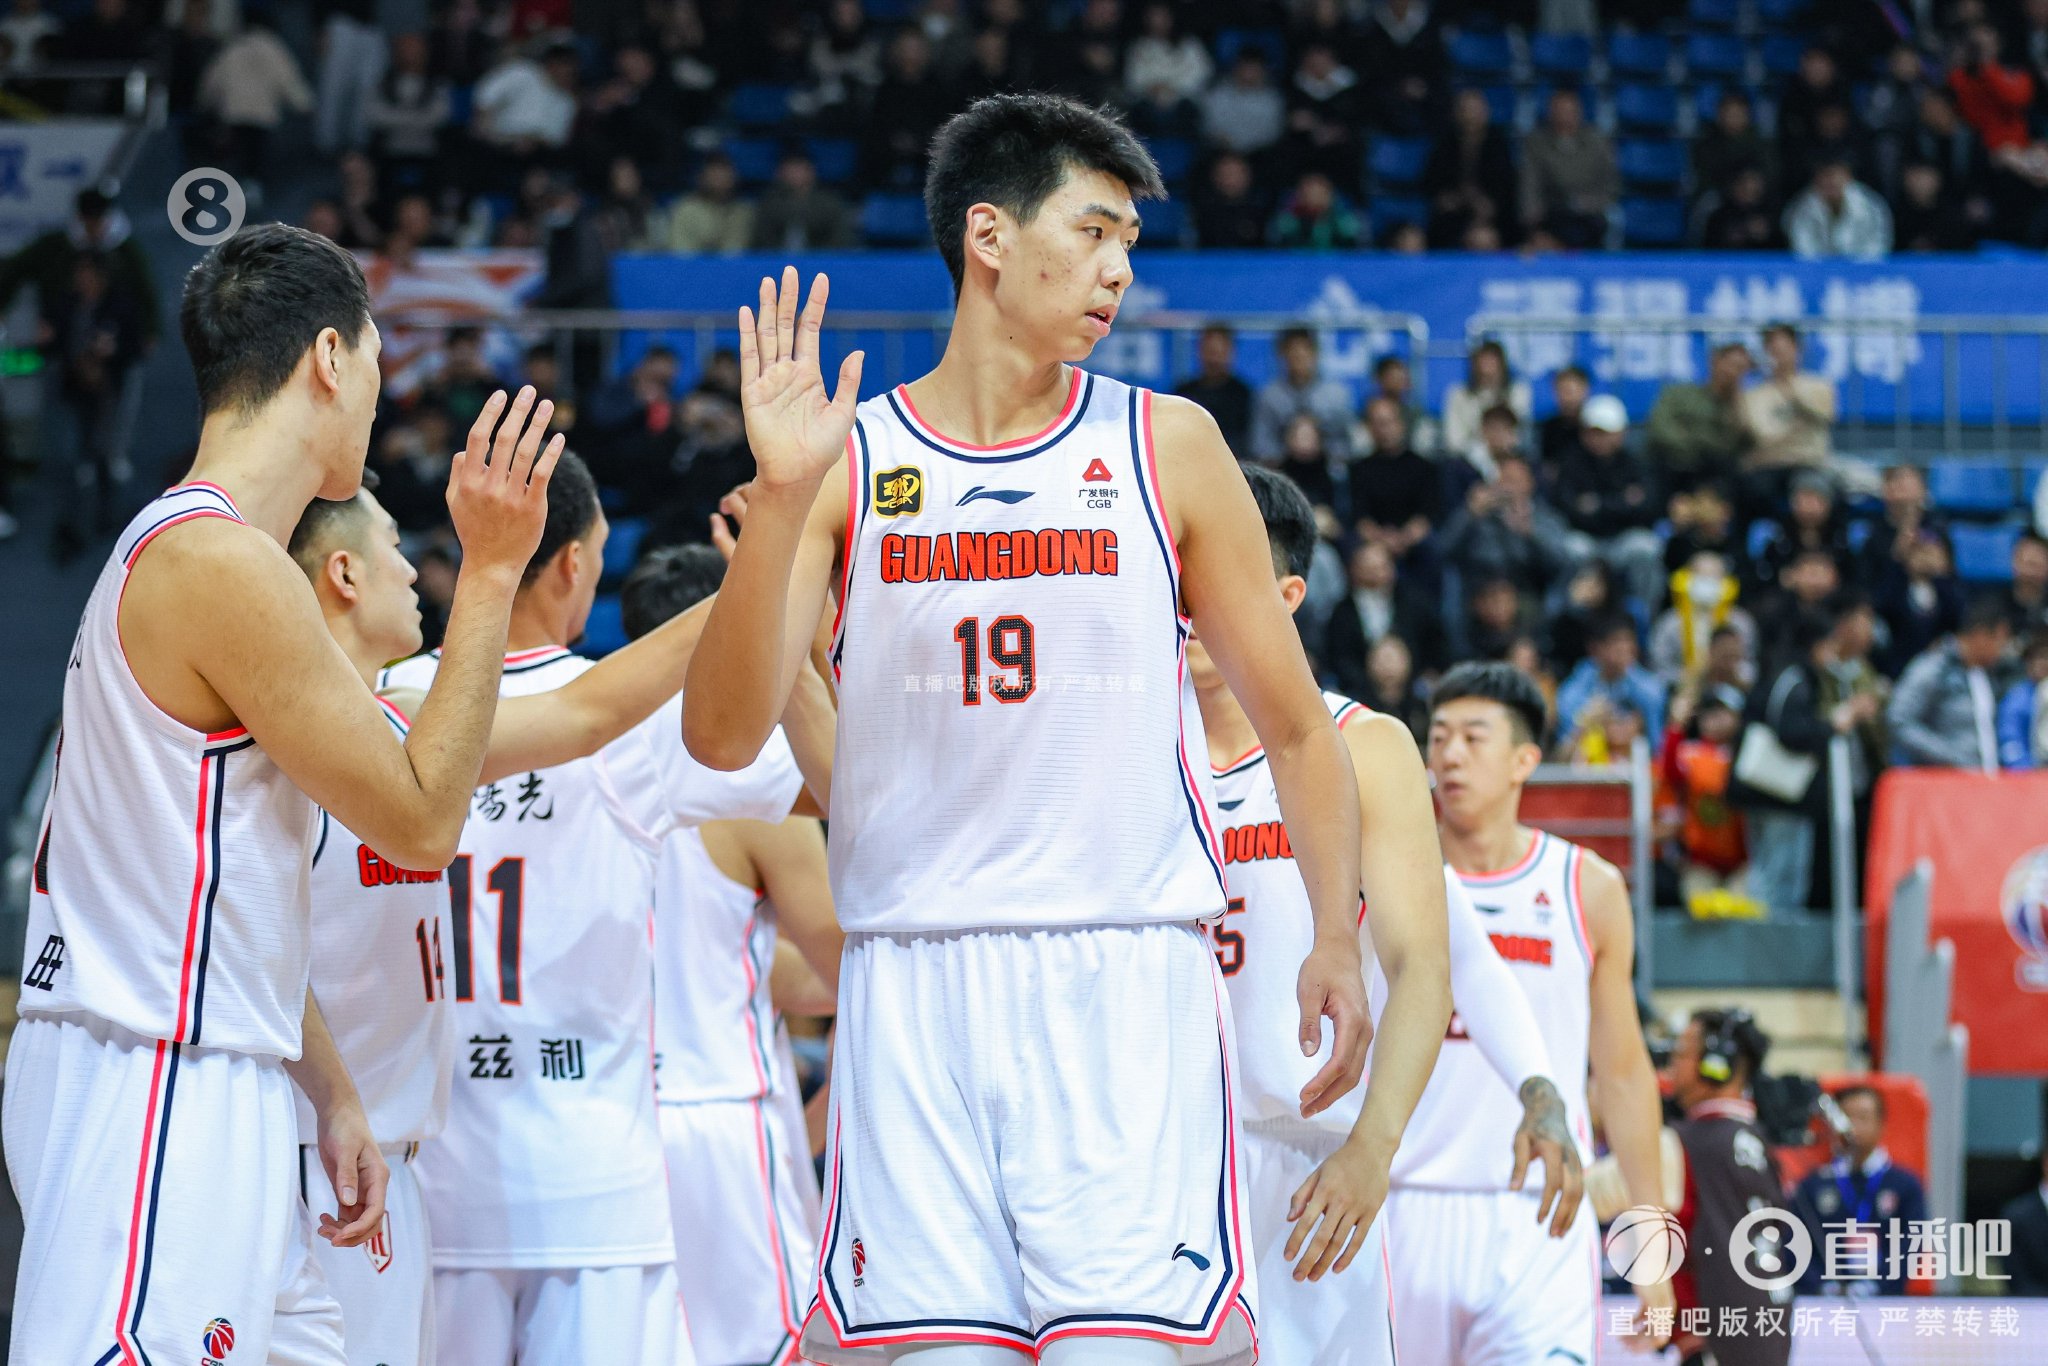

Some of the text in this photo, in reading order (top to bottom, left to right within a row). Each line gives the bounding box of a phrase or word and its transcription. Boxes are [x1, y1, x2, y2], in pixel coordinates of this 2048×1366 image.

[1078, 488, 1119, 499] 广发银行
[1086, 499, 1112, 509] CGB
[880, 528, 1119, 584] GUANGDONG
[953, 614, 1037, 706] 19
[447, 854, 526, 1007] 11
[1201, 896, 1247, 979] 5
